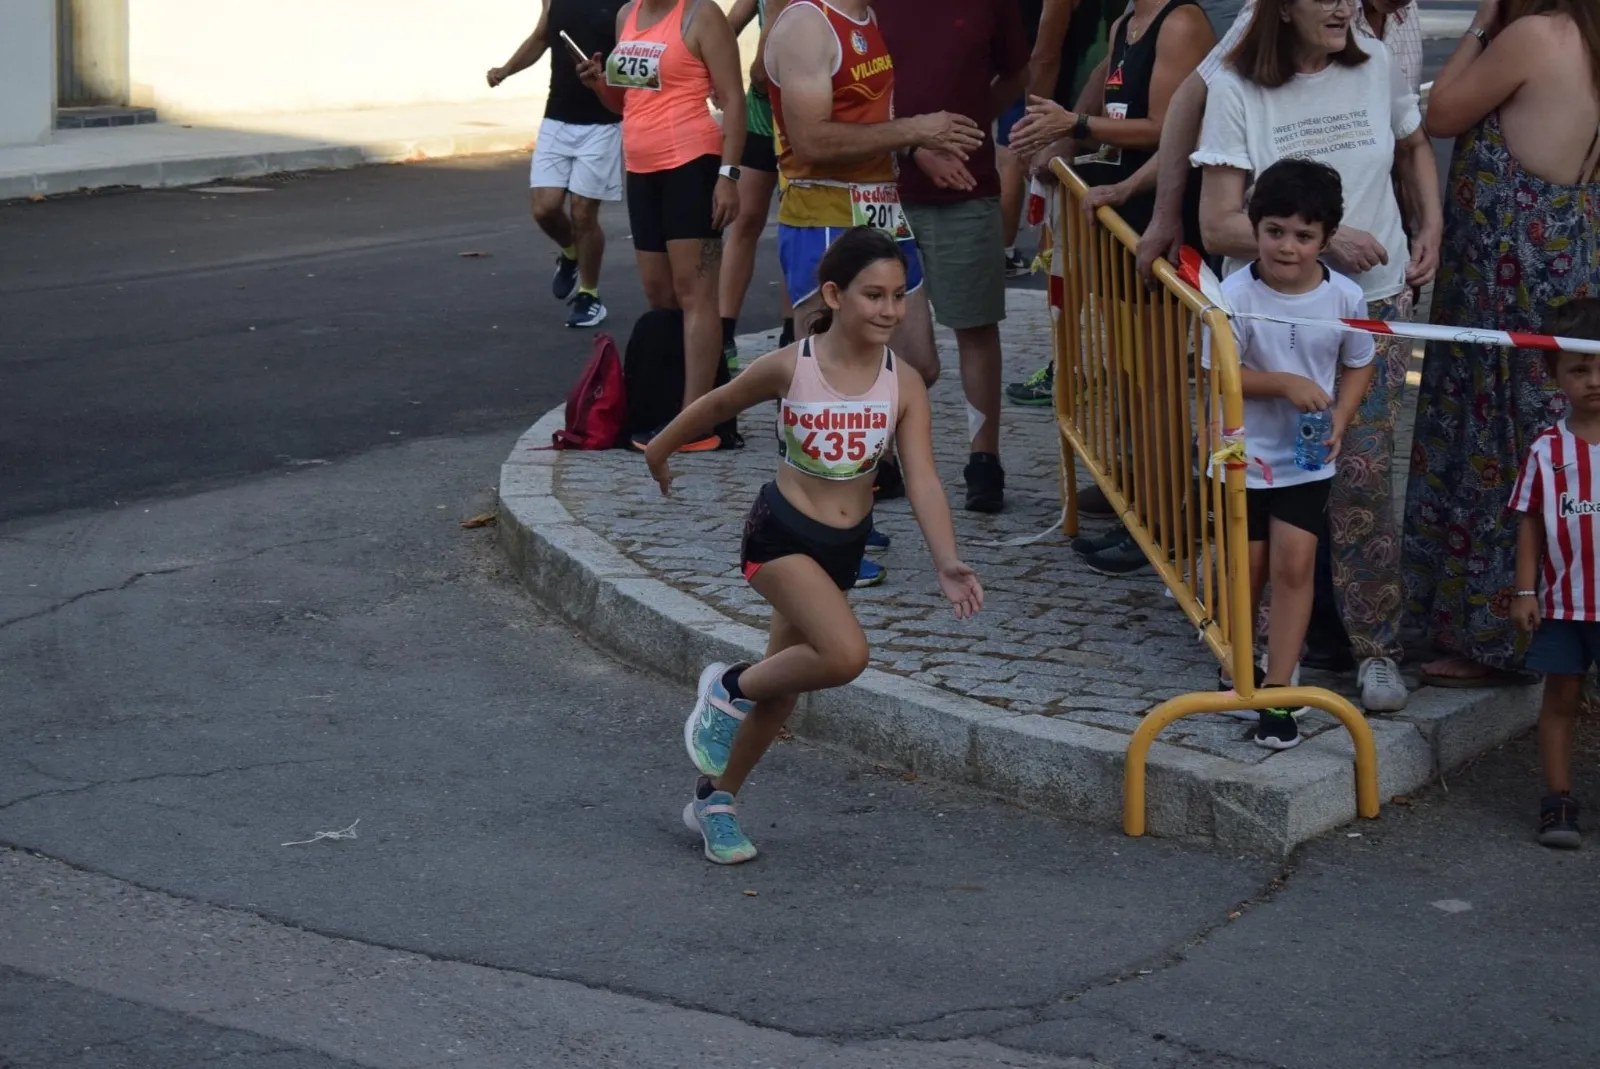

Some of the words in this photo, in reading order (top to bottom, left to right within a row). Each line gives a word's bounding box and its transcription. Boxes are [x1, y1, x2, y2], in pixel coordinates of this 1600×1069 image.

[617, 56, 649, 77] 275
[1272, 123, 1296, 134] SWEET
[1297, 117, 1321, 128] DREAM
[1322, 113, 1348, 124] COMES
[1348, 109, 1368, 120] TRUE
[1273, 132, 1298, 144] SWEET
[1300, 127, 1323, 137] DREAM
[1324, 122, 1351, 134] COMES
[1351, 119, 1370, 128] TRUE
[1303, 147, 1329, 157] DREAM
[1329, 141, 1357, 152] COMES
[1357, 137, 1376, 147] TRUE
[865, 204, 894, 228] 201
[783, 406, 887, 430] bedunia
[801, 431, 867, 462] 435
